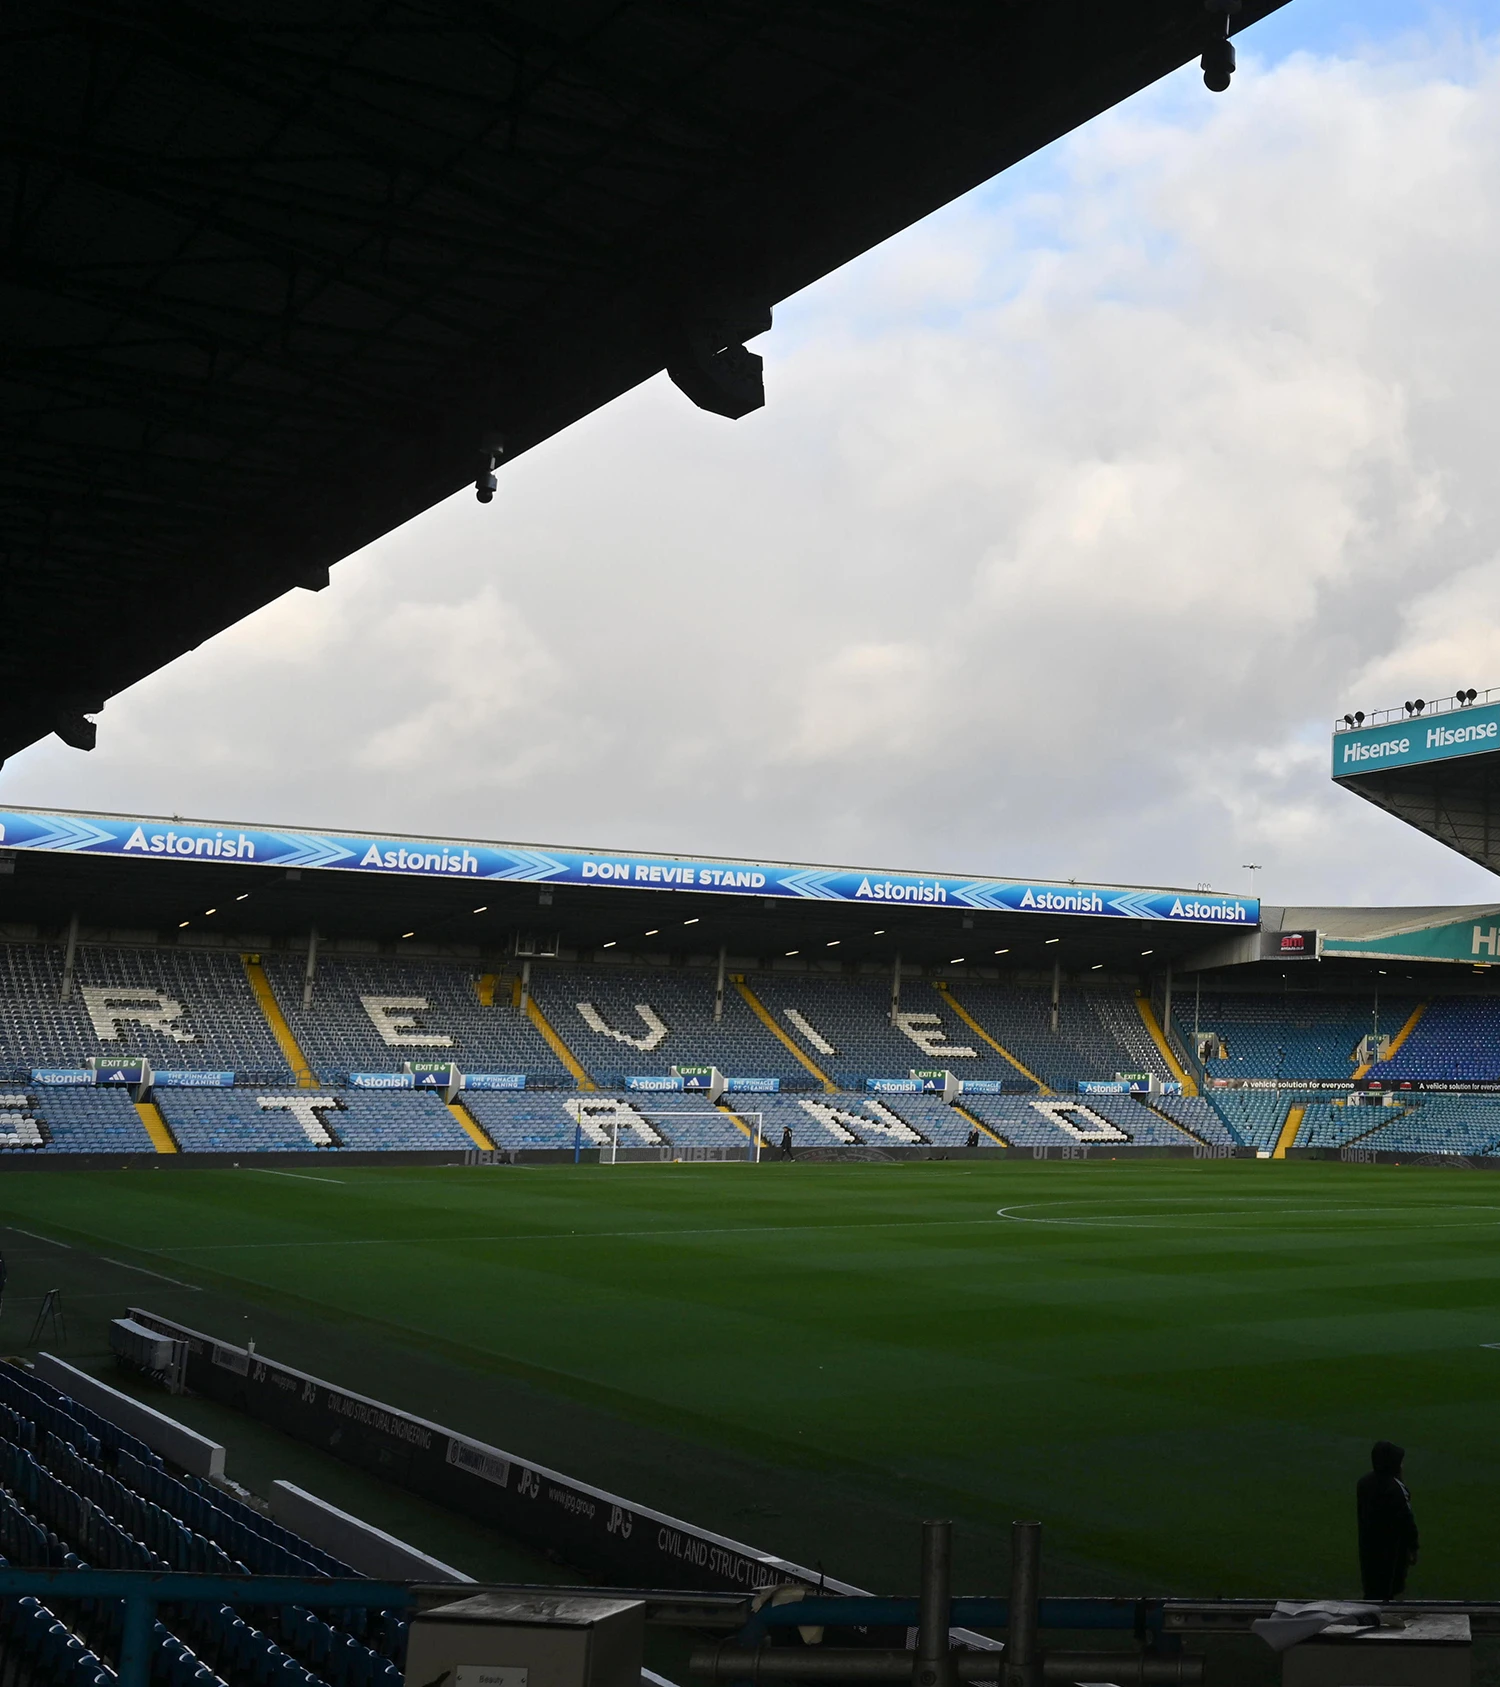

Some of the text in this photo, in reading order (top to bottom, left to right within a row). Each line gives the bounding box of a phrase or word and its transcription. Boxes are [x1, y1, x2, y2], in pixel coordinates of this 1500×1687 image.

[1425, 720, 1498, 748] Hisense
[1343, 736, 1410, 763] Hisense
[123, 825, 255, 860] Astonish
[359, 842, 478, 874] Astonish
[581, 860, 766, 889] DON REVIE STAND
[855, 876, 947, 903] Astonish
[1019, 887, 1103, 913] Astonish
[1169, 897, 1246, 922] Astonish
[101, 1059, 121, 1068] EXIT
[415, 1063, 433, 1071] EXIT
[34, 1071, 92, 1084] Astonish
[680, 1067, 697, 1075] EXIT
[354, 1075, 409, 1088] Astonish
[630, 1078, 678, 1091] Astonish
[874, 1081, 916, 1093] Astonish
[1086, 1083, 1123, 1094] Astonish
[1321, 1082, 1355, 1090] everyone
[1449, 1082, 1471, 1090] solution
[660, 1147, 730, 1161] UNIBET
[1340, 1149, 1378, 1164] UNIBET
[353, 1403, 391, 1433] STRUCTURAL
[390, 1417, 432, 1450] ENGINEERING
[517, 1468, 596, 1520] JPG www.jpg.group
[606, 1505, 633, 1539] JPG
[657, 1527, 683, 1560] CIVIL
[683, 1538, 708, 1567] AND
[479, 1675, 504, 1685] Beauty
